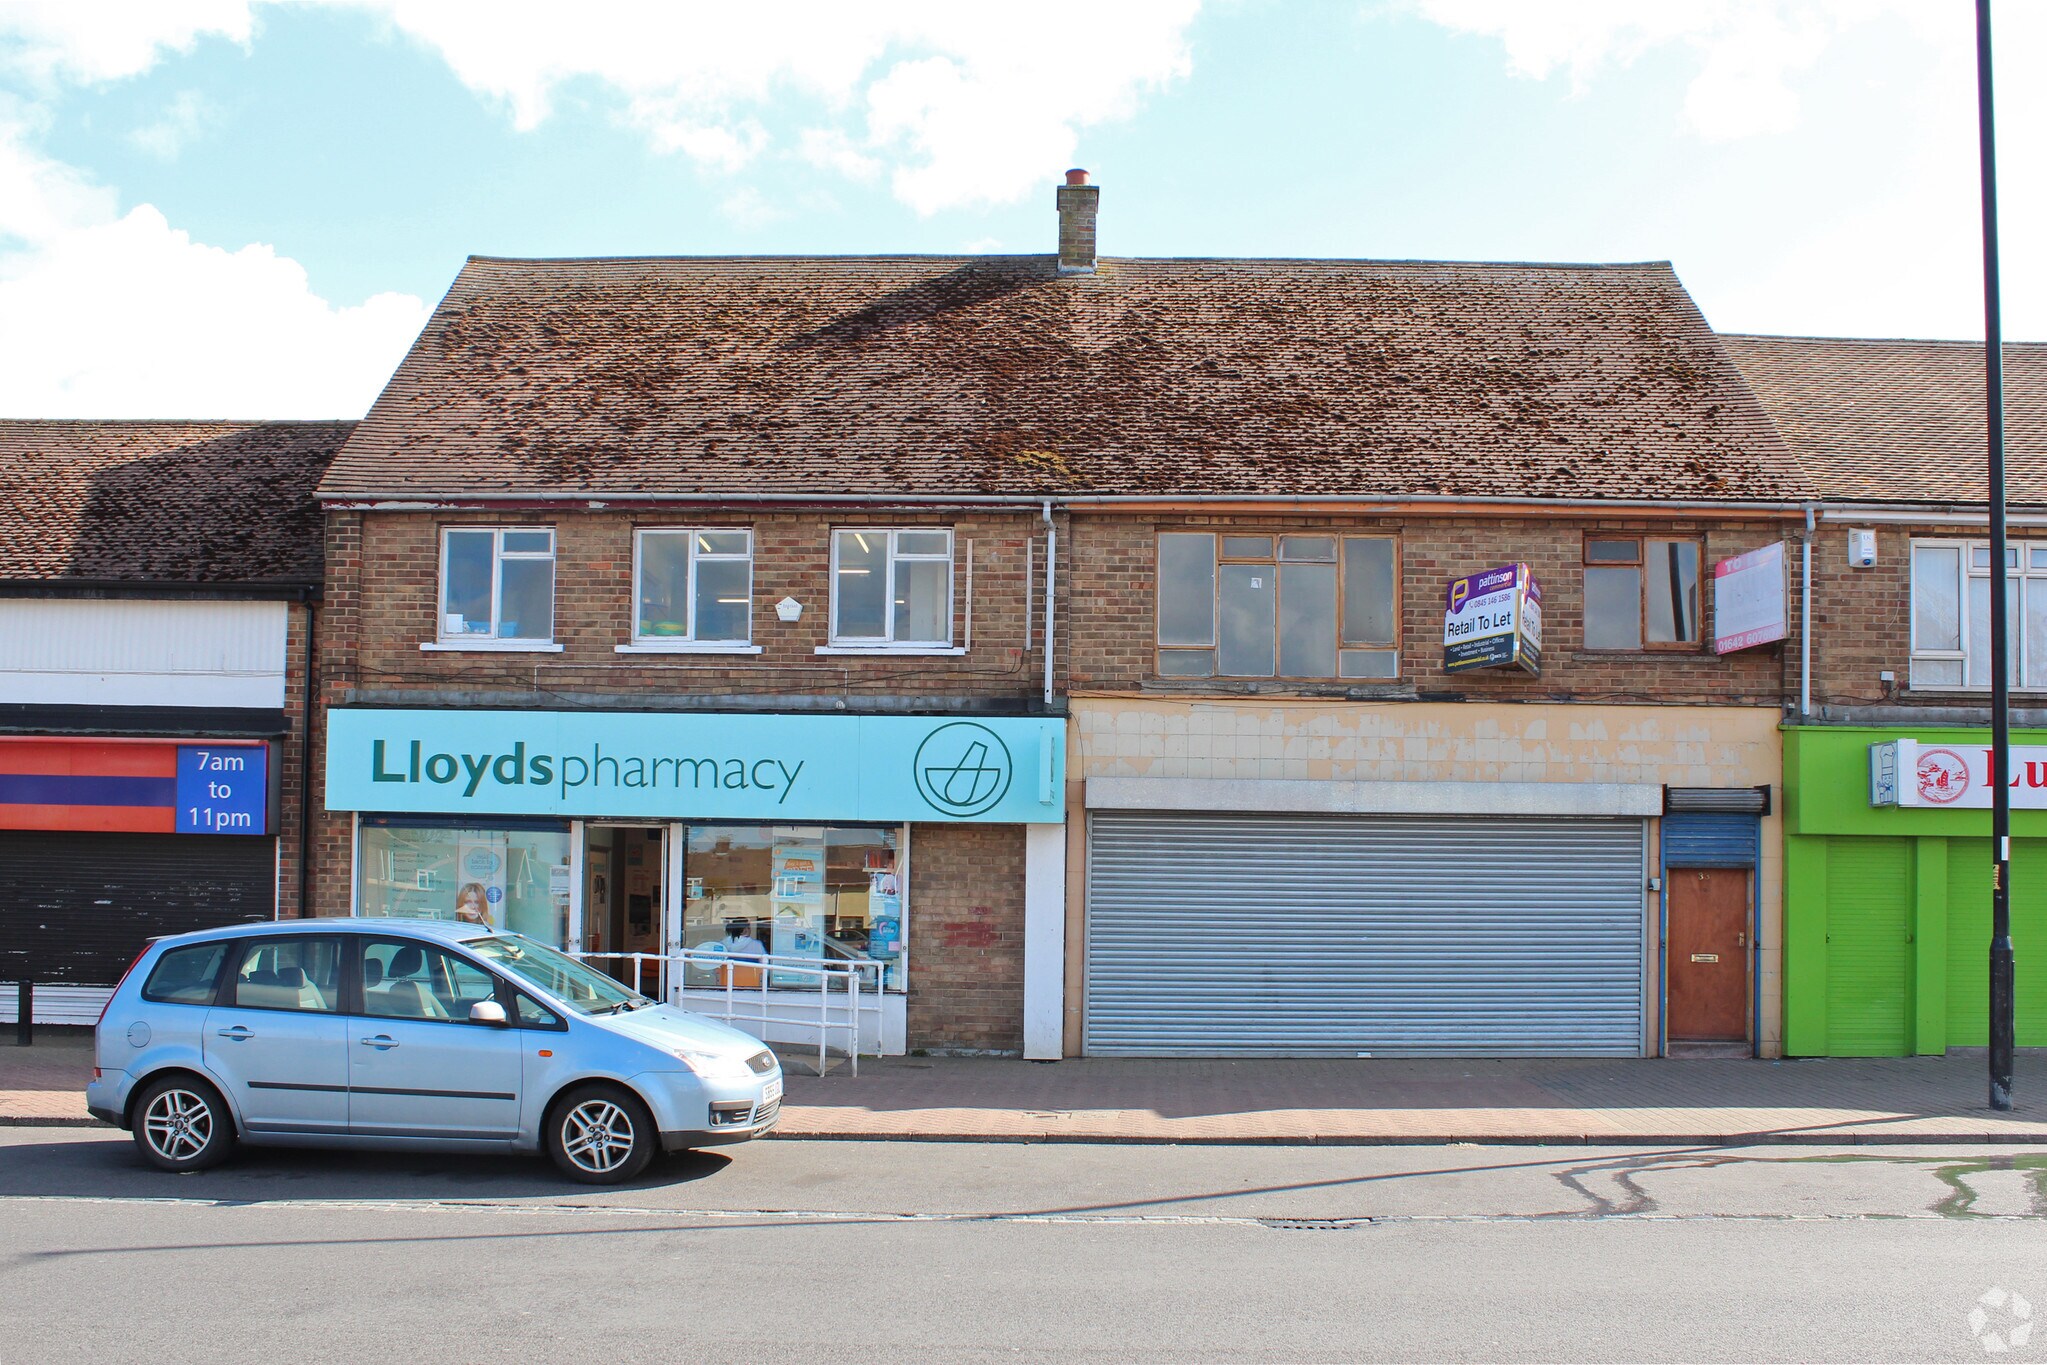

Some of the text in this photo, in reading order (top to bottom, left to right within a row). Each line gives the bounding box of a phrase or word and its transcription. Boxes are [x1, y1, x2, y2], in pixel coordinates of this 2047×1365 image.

[1478, 571, 1513, 590] pattinson
[1448, 611, 1512, 637] Retail To Let
[1718, 636, 1744, 652] 01642
[197, 752, 245, 771] 7am
[208, 781, 232, 799] to
[189, 807, 251, 832] 11pm
